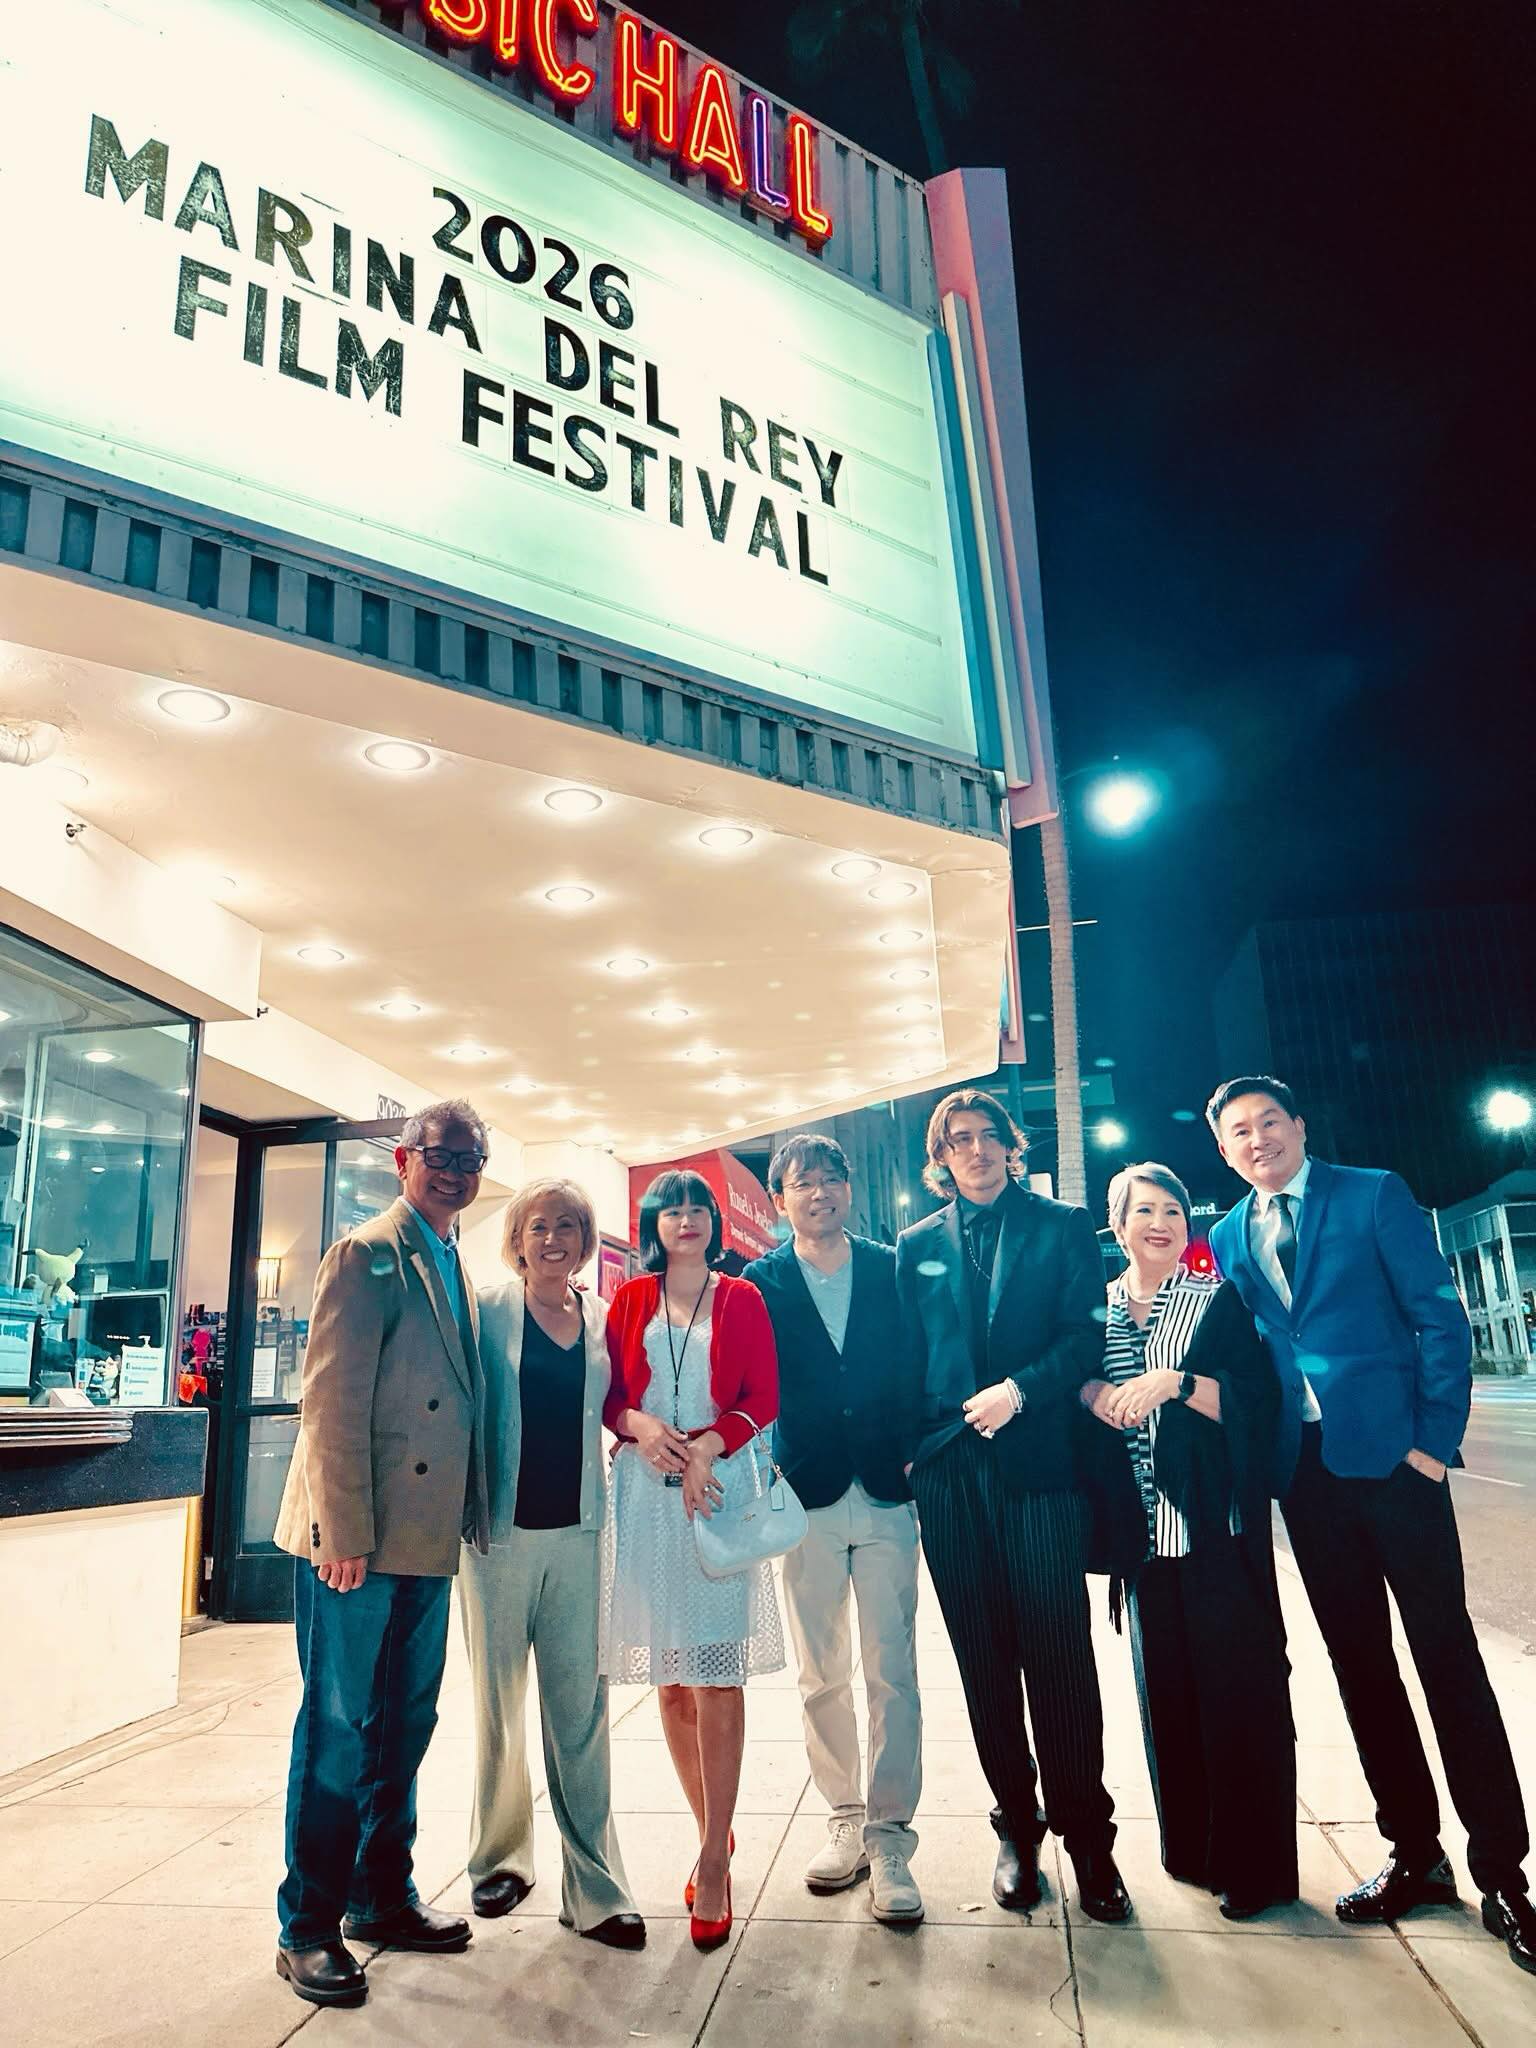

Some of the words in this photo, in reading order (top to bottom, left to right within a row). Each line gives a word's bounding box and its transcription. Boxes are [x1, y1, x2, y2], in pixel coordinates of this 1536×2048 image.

[613, 11, 833, 242] HALL
[85, 113, 484, 355] MARINA
[544, 315, 680, 439] DEL
[719, 395, 843, 508] REY
[432, 186, 635, 331] 2026
[173, 254, 404, 418] FILM
[461, 367, 829, 586] FESTIVAL
[1190, 1202, 1217, 1216] ord
